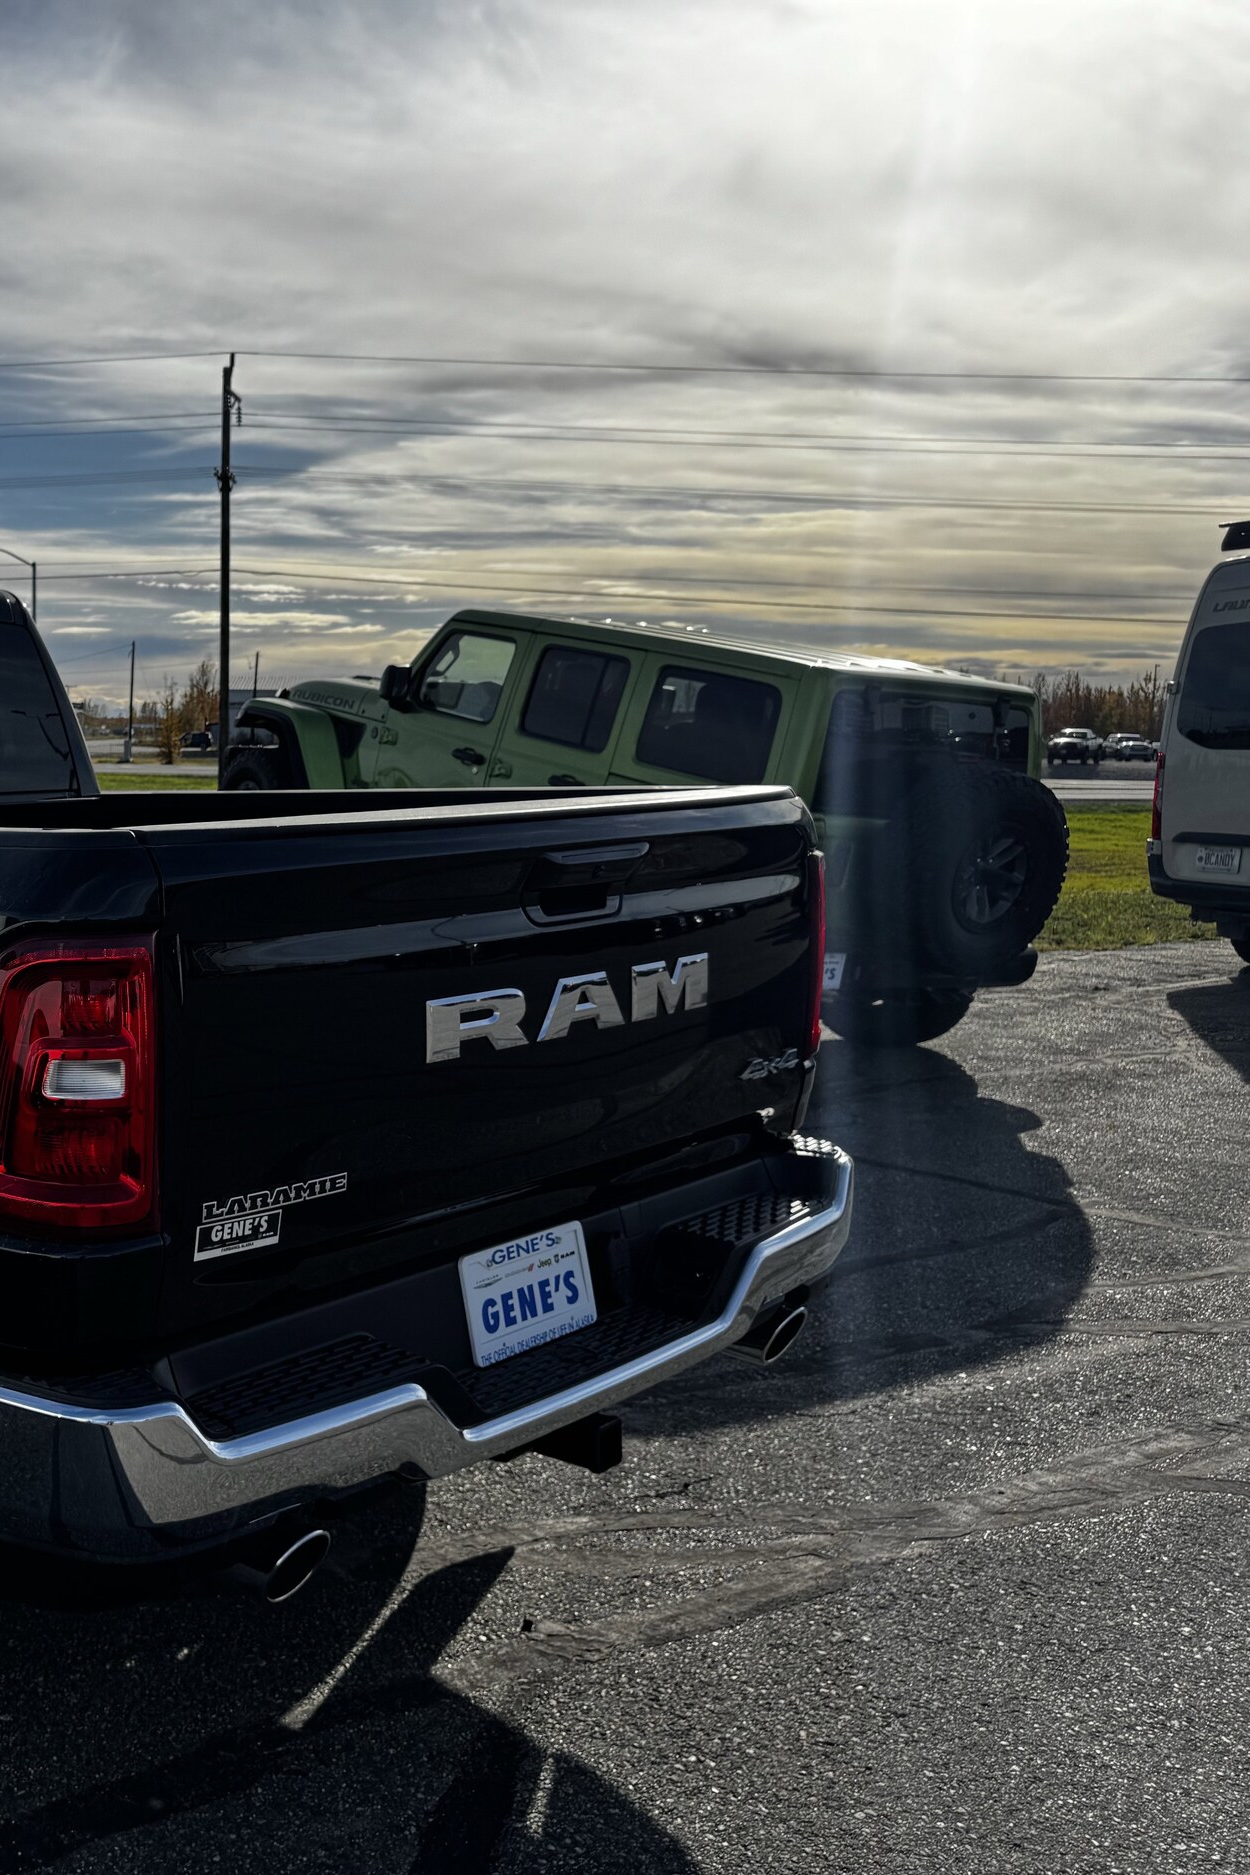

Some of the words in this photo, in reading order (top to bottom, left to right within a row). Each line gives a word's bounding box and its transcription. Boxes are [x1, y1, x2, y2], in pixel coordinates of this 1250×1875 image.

[292, 688, 357, 710] RUBICON
[426, 952, 709, 1065] RAM
[202, 1171, 348, 1224] LARAMIE
[210, 1214, 269, 1243] GENE'S
[491, 1232, 556, 1265] GENE'S
[536, 1257, 552, 1269] Jeep
[481, 1269, 580, 1335] GENE'S
